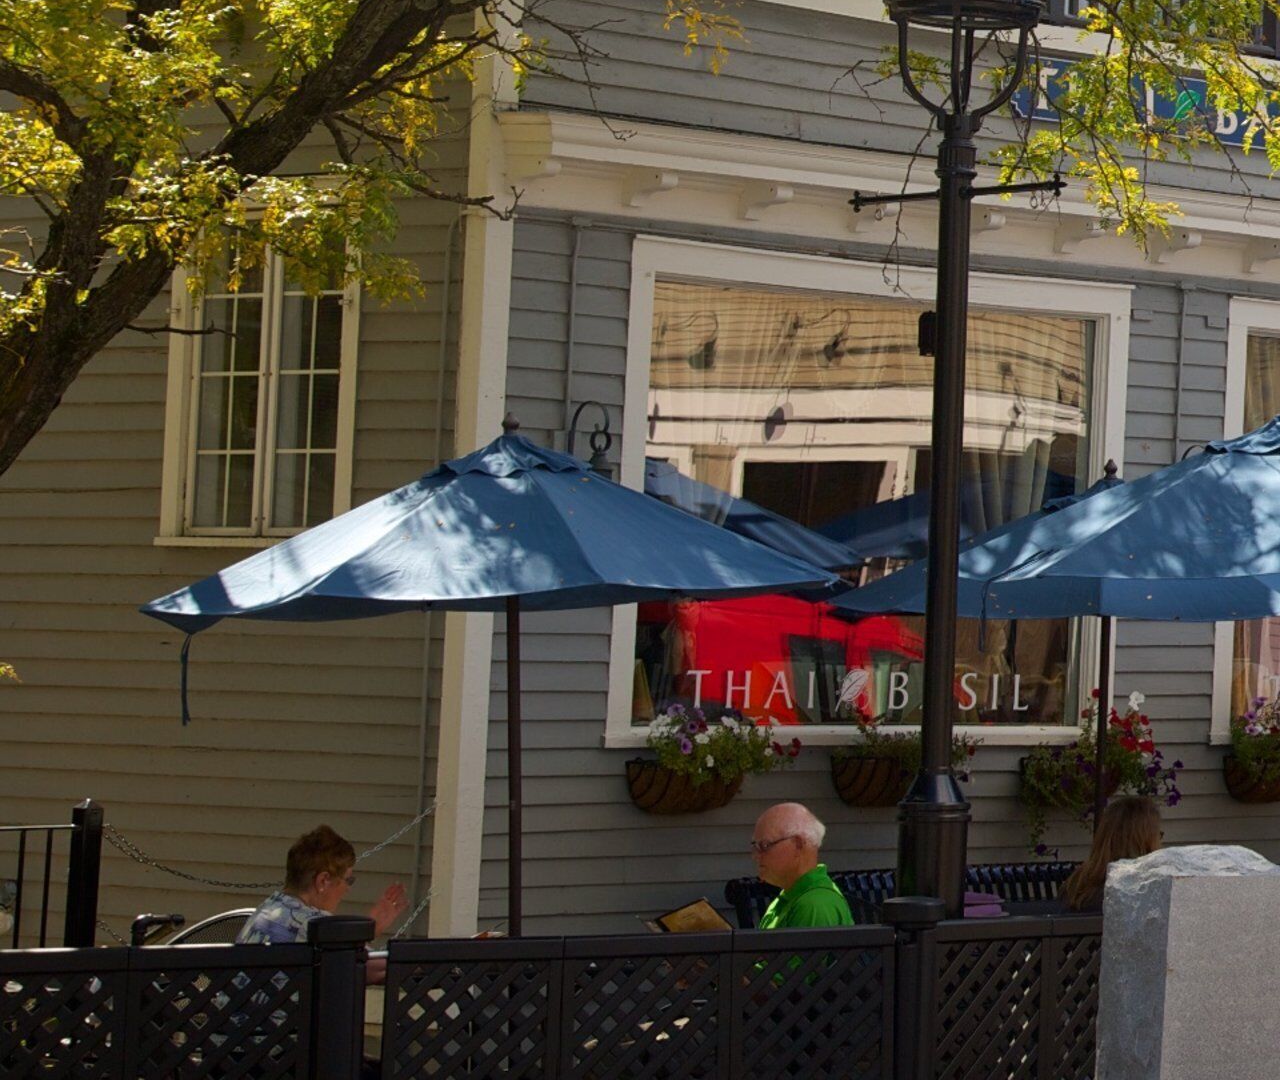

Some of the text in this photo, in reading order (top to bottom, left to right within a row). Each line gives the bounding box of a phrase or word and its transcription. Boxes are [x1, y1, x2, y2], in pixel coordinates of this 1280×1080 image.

[1036, 67, 1154, 126] TI
[686, 670, 1029, 710] THAI BSIL
